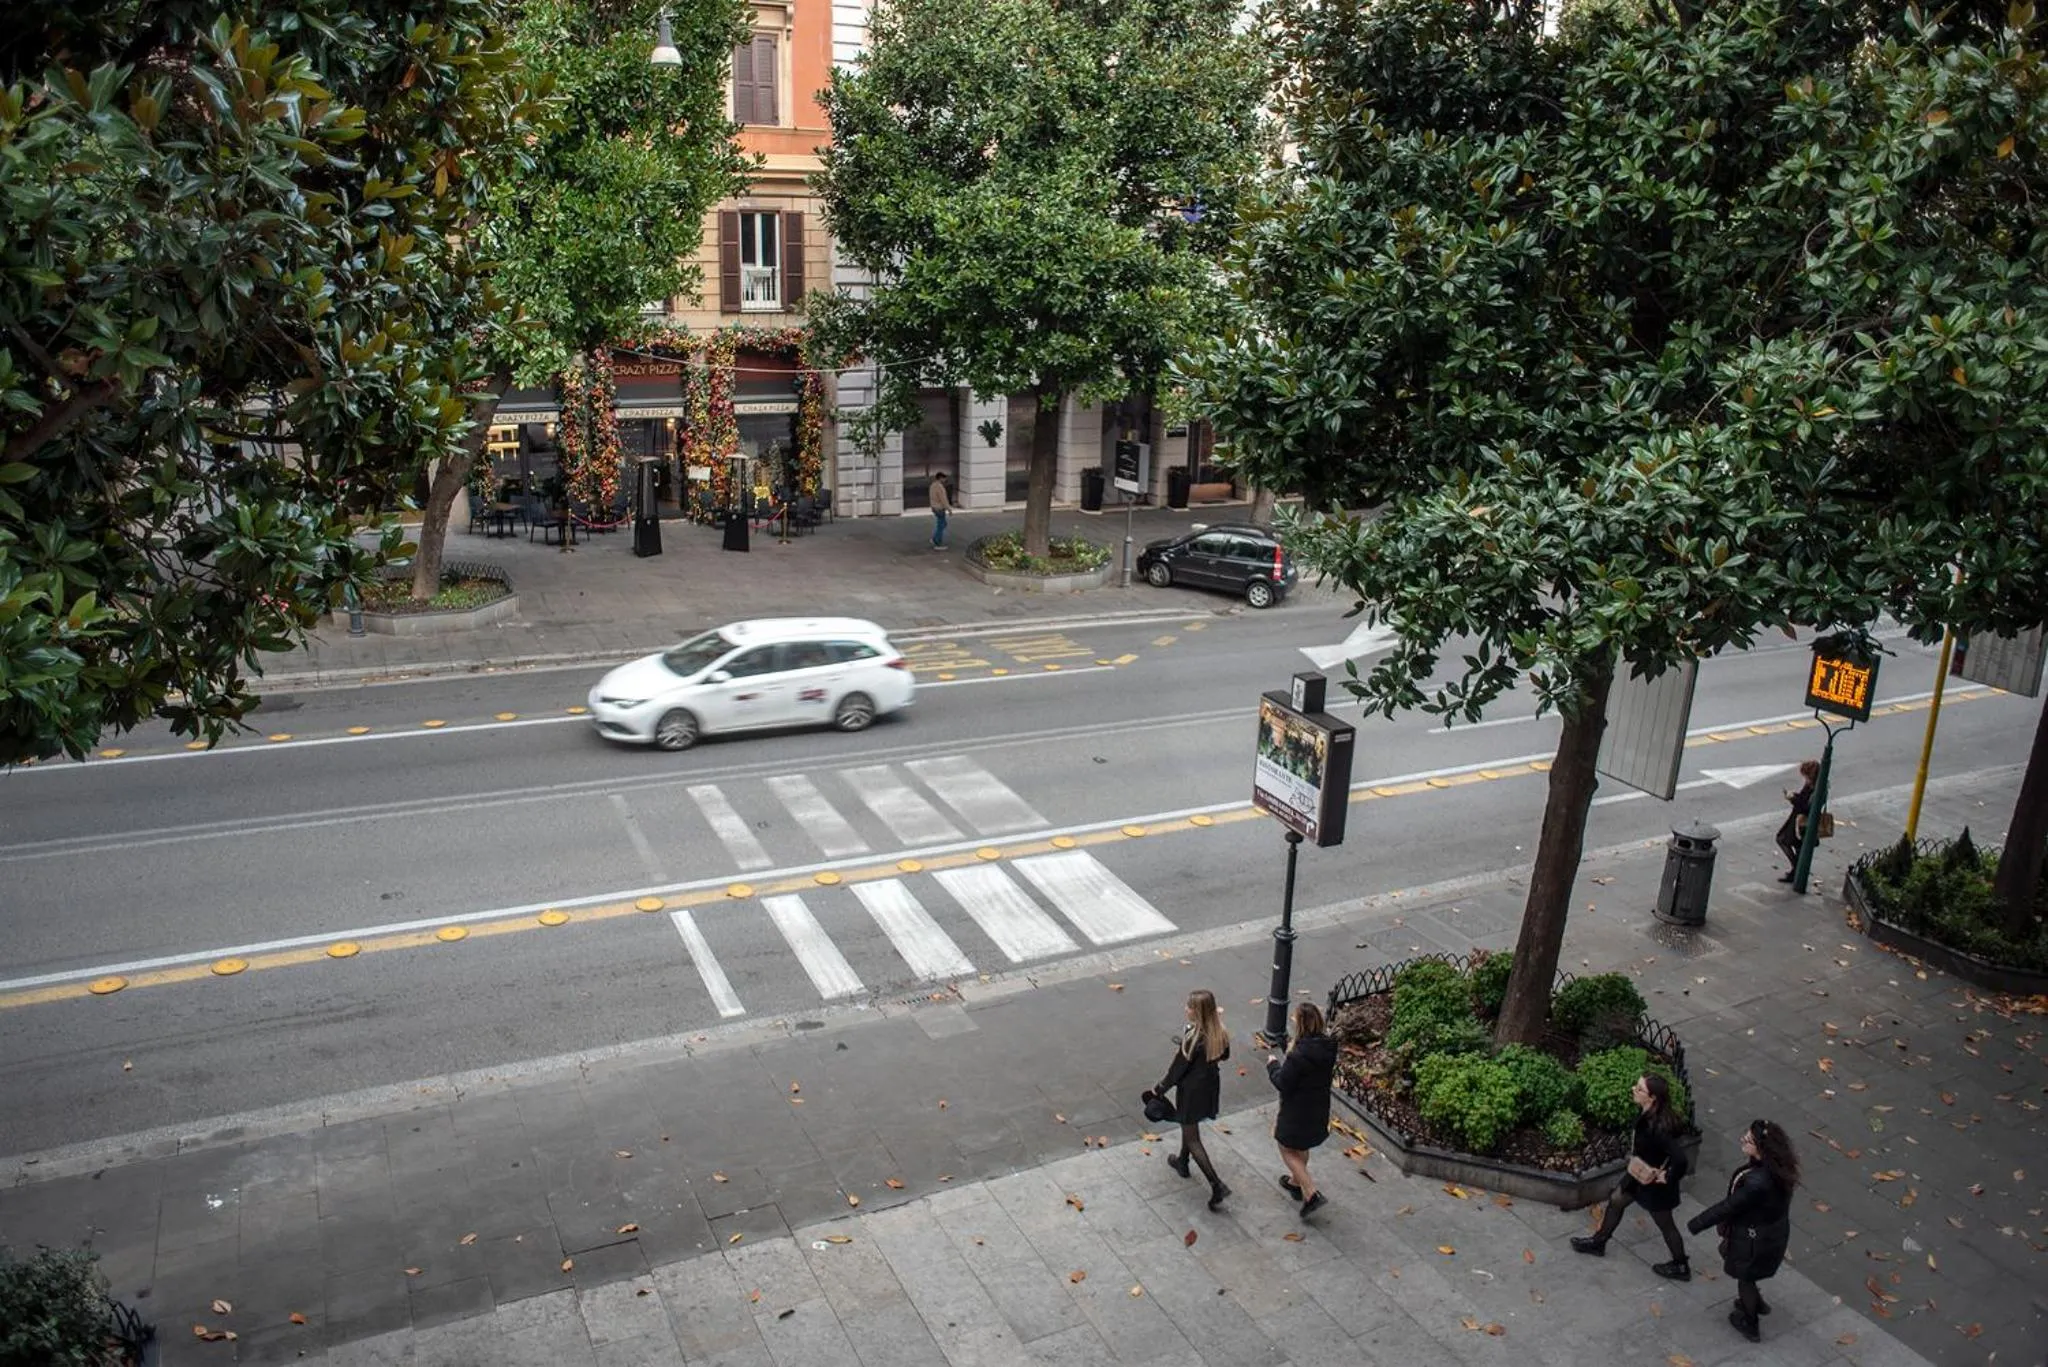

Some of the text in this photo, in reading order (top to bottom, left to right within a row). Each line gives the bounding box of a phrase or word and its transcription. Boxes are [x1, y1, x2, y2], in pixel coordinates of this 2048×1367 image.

[613, 363, 680, 375] CRAZY PIZZA
[624, 408, 651, 416] CRAZY
[495, 413, 550, 422] CRAZY PIZZA
